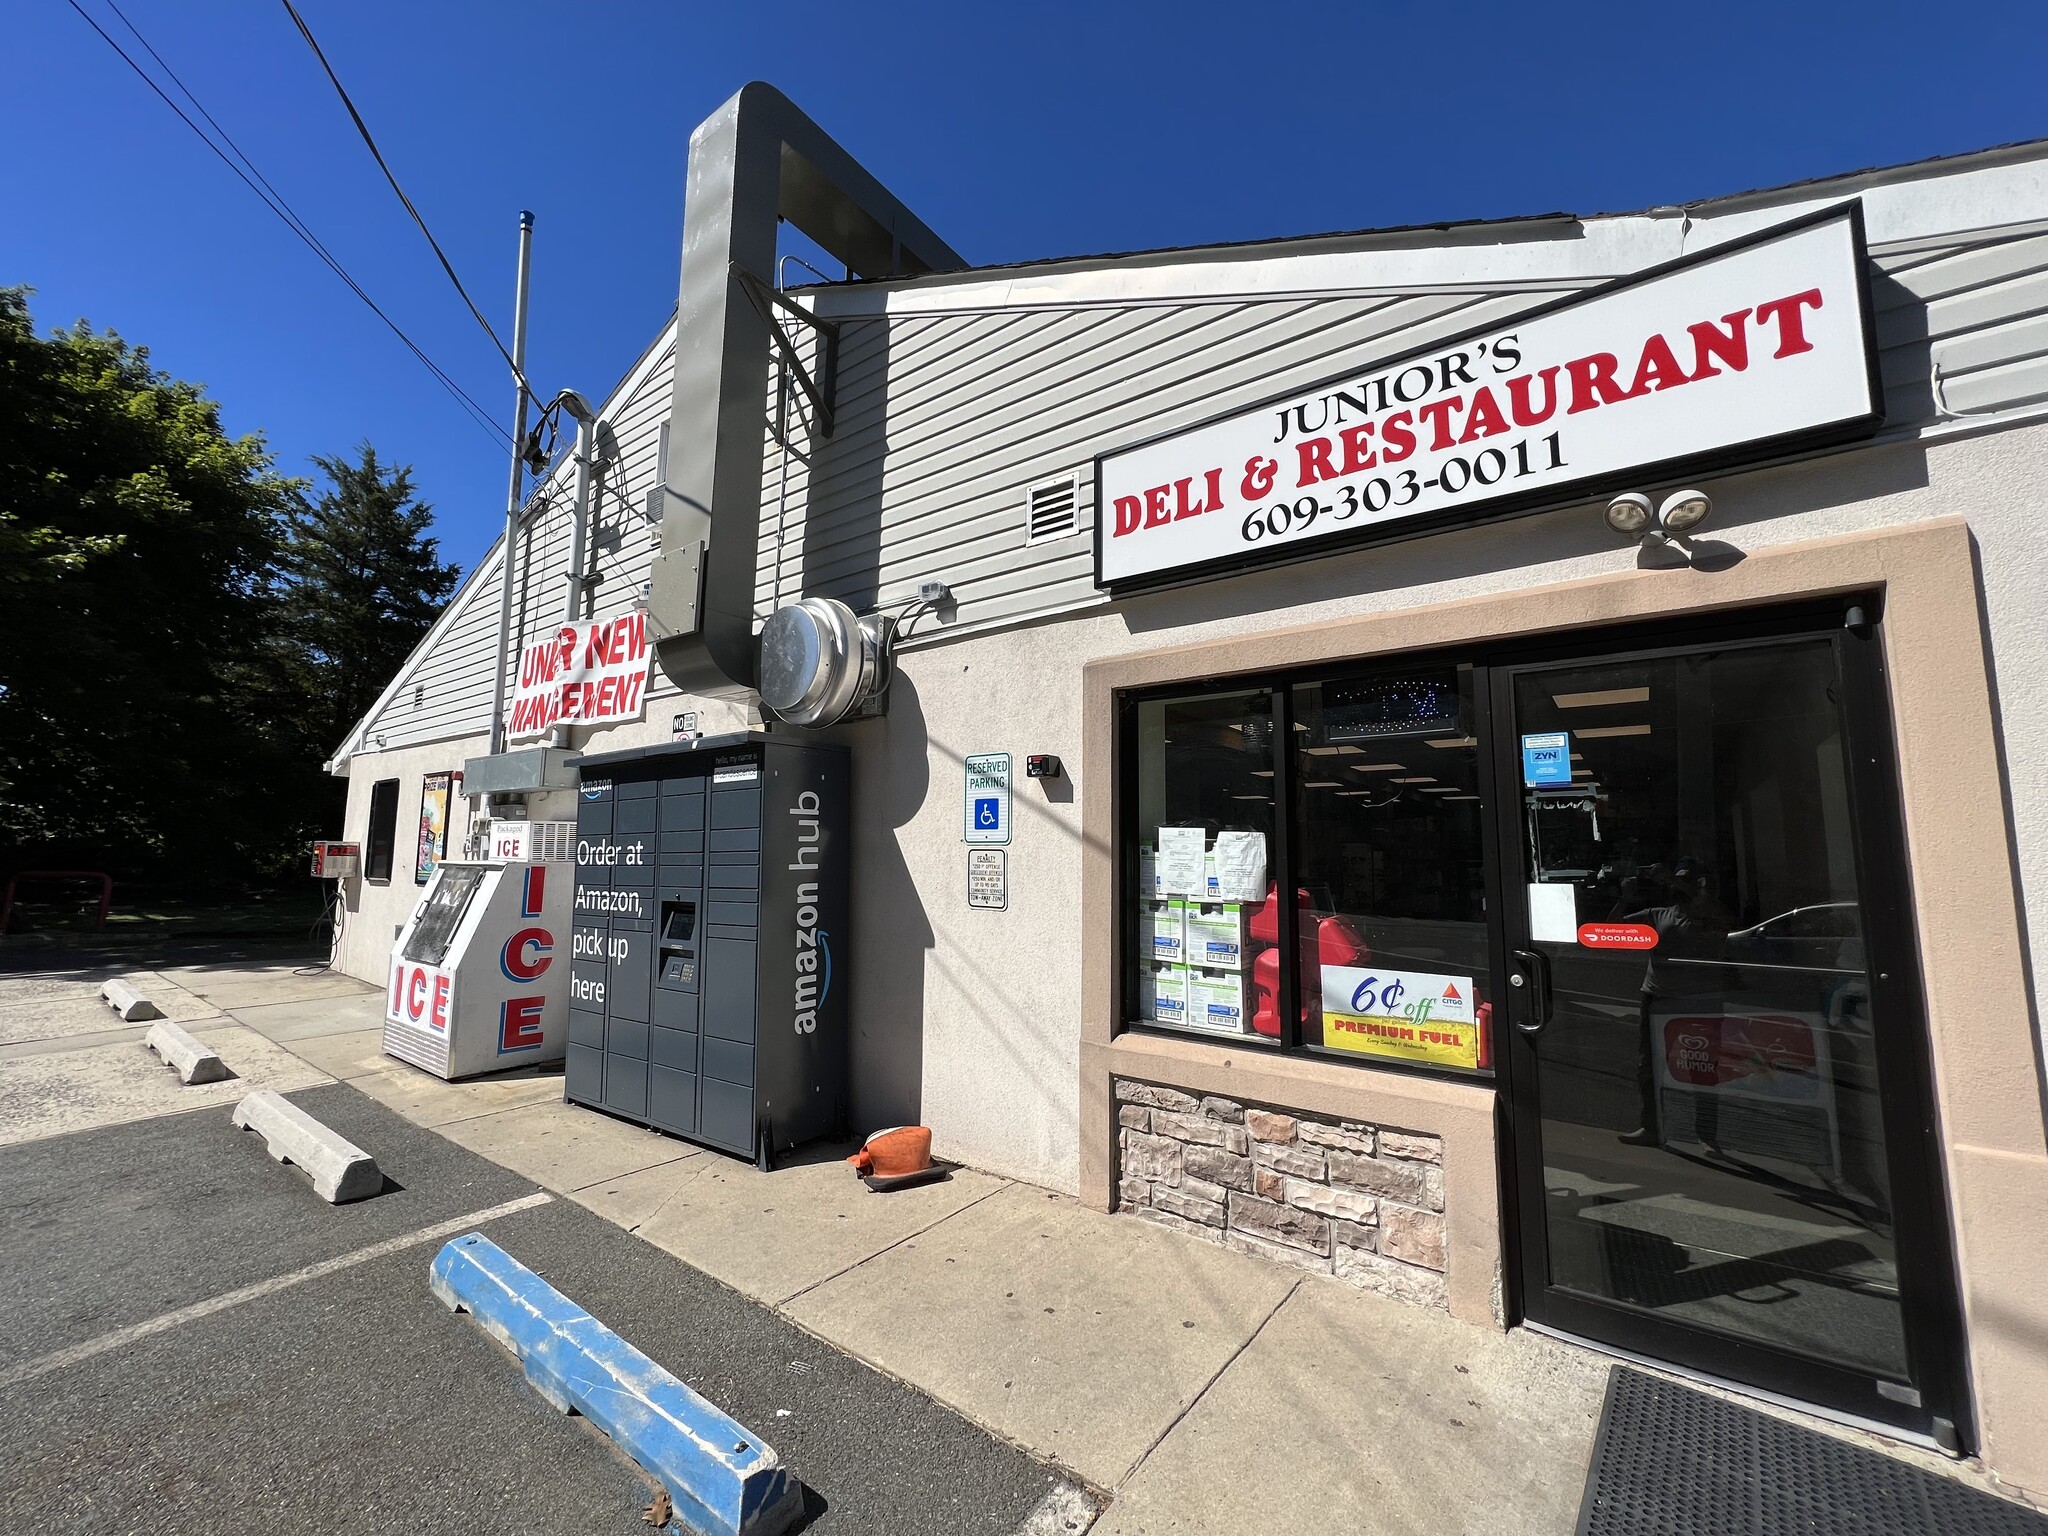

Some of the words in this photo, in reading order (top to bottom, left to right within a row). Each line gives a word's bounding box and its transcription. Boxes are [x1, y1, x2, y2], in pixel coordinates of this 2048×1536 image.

[1274, 334, 1523, 443] JUNIOR'S
[1112, 467, 1225, 539] DELI
[1240, 455, 1278, 501] &
[1296, 288, 1823, 489] RESTAURANT
[1241, 430, 1569, 542] 609-303-0011
[521, 627, 577, 689] UNDR
[585, 613, 646, 669] NEW
[508, 670, 646, 734] MANAEMENT
[673, 717, 684, 730] NO
[967, 760, 1008, 774] RESERVED
[1534, 751, 1557, 760] ZYN
[580, 779, 612, 793] amazon
[970, 776, 1005, 789] PARKING
[788, 790, 820, 870] hub
[497, 839, 520, 857] ICE
[577, 839, 622, 865] Order
[625, 840, 643, 865] at
[575, 885, 642, 918] Amazon,
[572, 928, 602, 959] pick
[608, 937, 629, 965] up
[1600, 935, 1652, 943] DOORDASH
[497, 866, 555, 1055] ICE
[794, 882, 819, 1035] amazon
[392, 963, 450, 1033] ICE
[571, 971, 605, 1002] here
[1351, 976, 1405, 1015] 6¢
[1403, 997, 1435, 1026] off
[1442, 998, 1463, 1006] CITGO
[1334, 1019, 1414, 1040] PREMIUM
[1419, 1030, 1463, 1047] FUEL
[1676, 1060, 1716, 1073] HUMOR
[1680, 1050, 1709, 1062] GOOD
